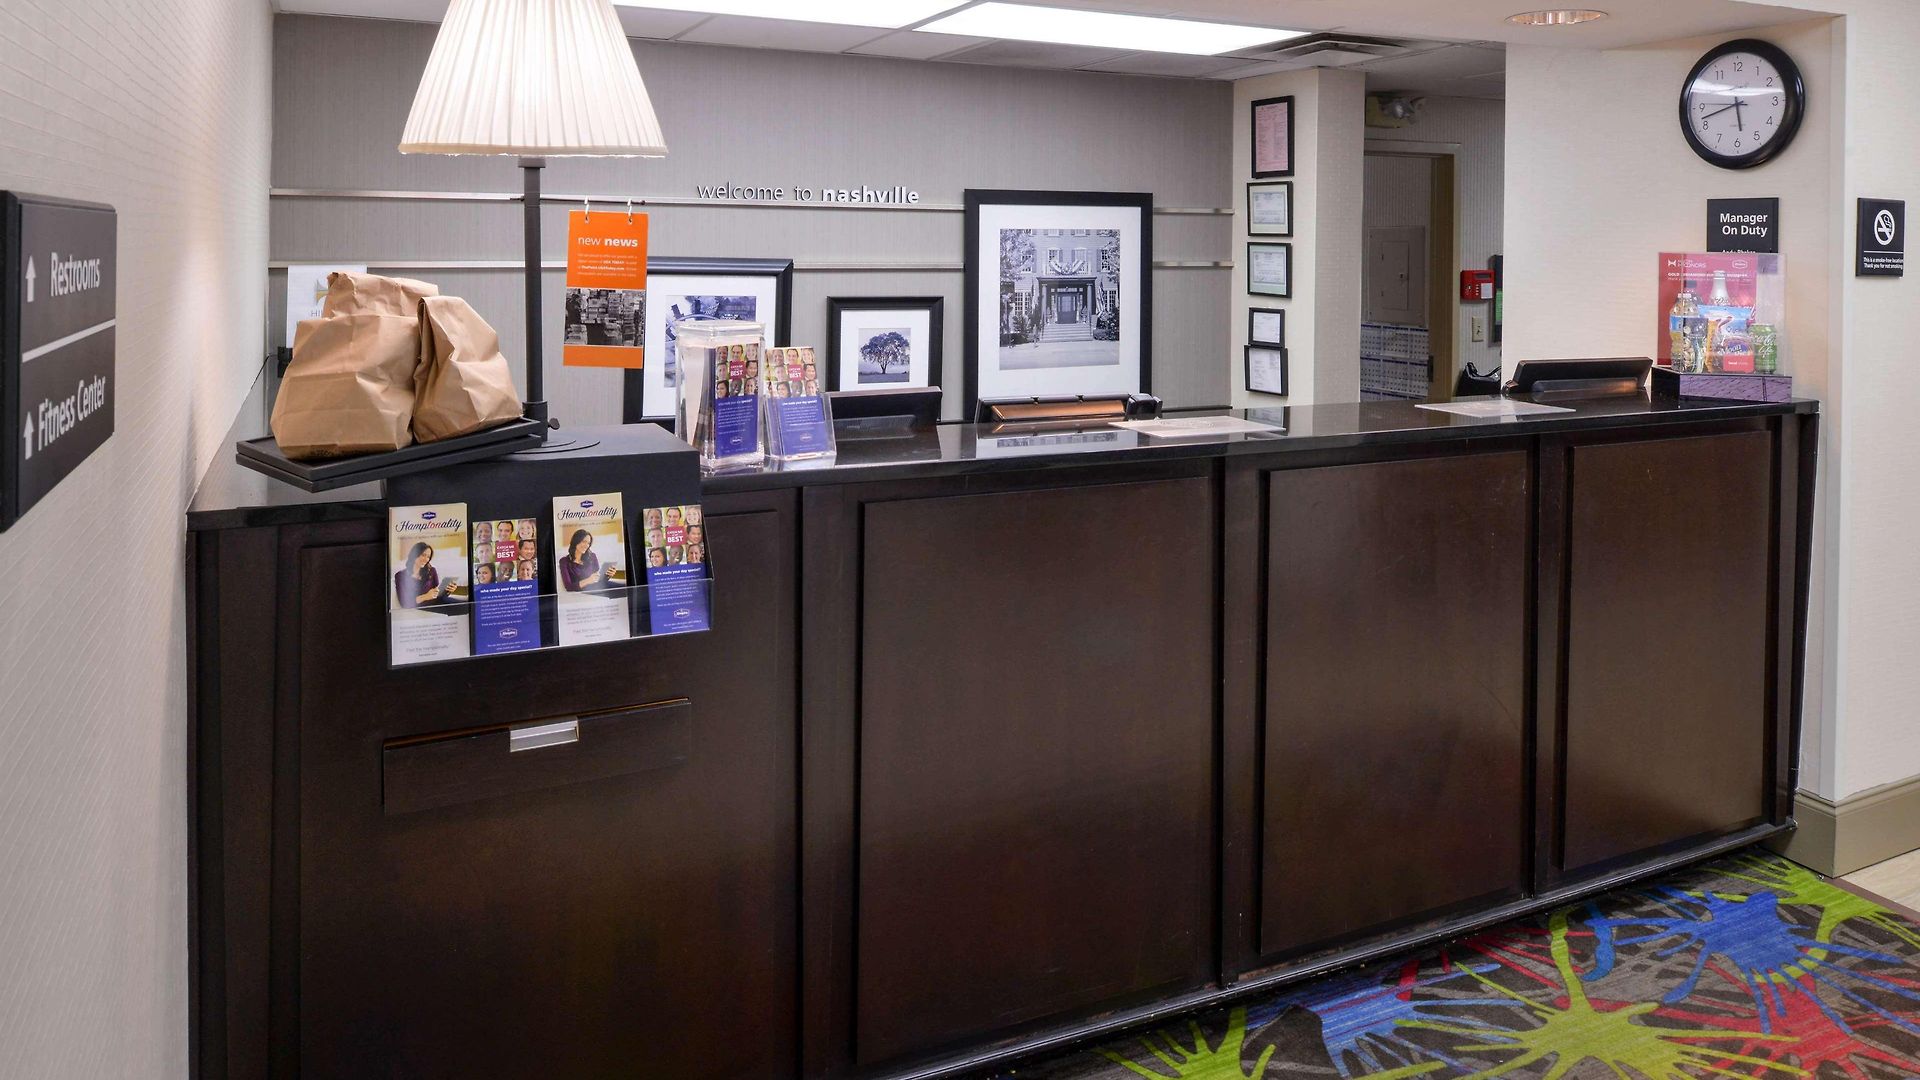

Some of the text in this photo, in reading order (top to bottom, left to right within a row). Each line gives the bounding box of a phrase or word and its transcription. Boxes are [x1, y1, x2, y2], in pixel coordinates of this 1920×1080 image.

[1733, 61, 1743, 72] 12
[1755, 66, 1760, 76] 1
[1715, 70, 1724, 80] 11
[1766, 77, 1773, 87] 2
[1771, 96, 1779, 106] 3
[1699, 102, 1706, 112] 9
[1702, 120, 1709, 130] 8
[1766, 115, 1773, 126] 4
[1716, 133, 1722, 143] 7
[1753, 131, 1760, 140] 5
[1734, 138, 1741, 148] 6
[697, 182, 920, 204] welcome to nashville
[1720, 213, 1768, 225] Manager
[1722, 225, 1768, 237] On Duty
[577, 237, 638, 247] new news
[50, 252, 101, 297] Restrooms
[38, 375, 106, 452] Fitness Center
[557, 506, 618, 520] Hamptonality
[396, 518, 462, 532] Hamptonality
[496, 551, 515, 559] BEST
